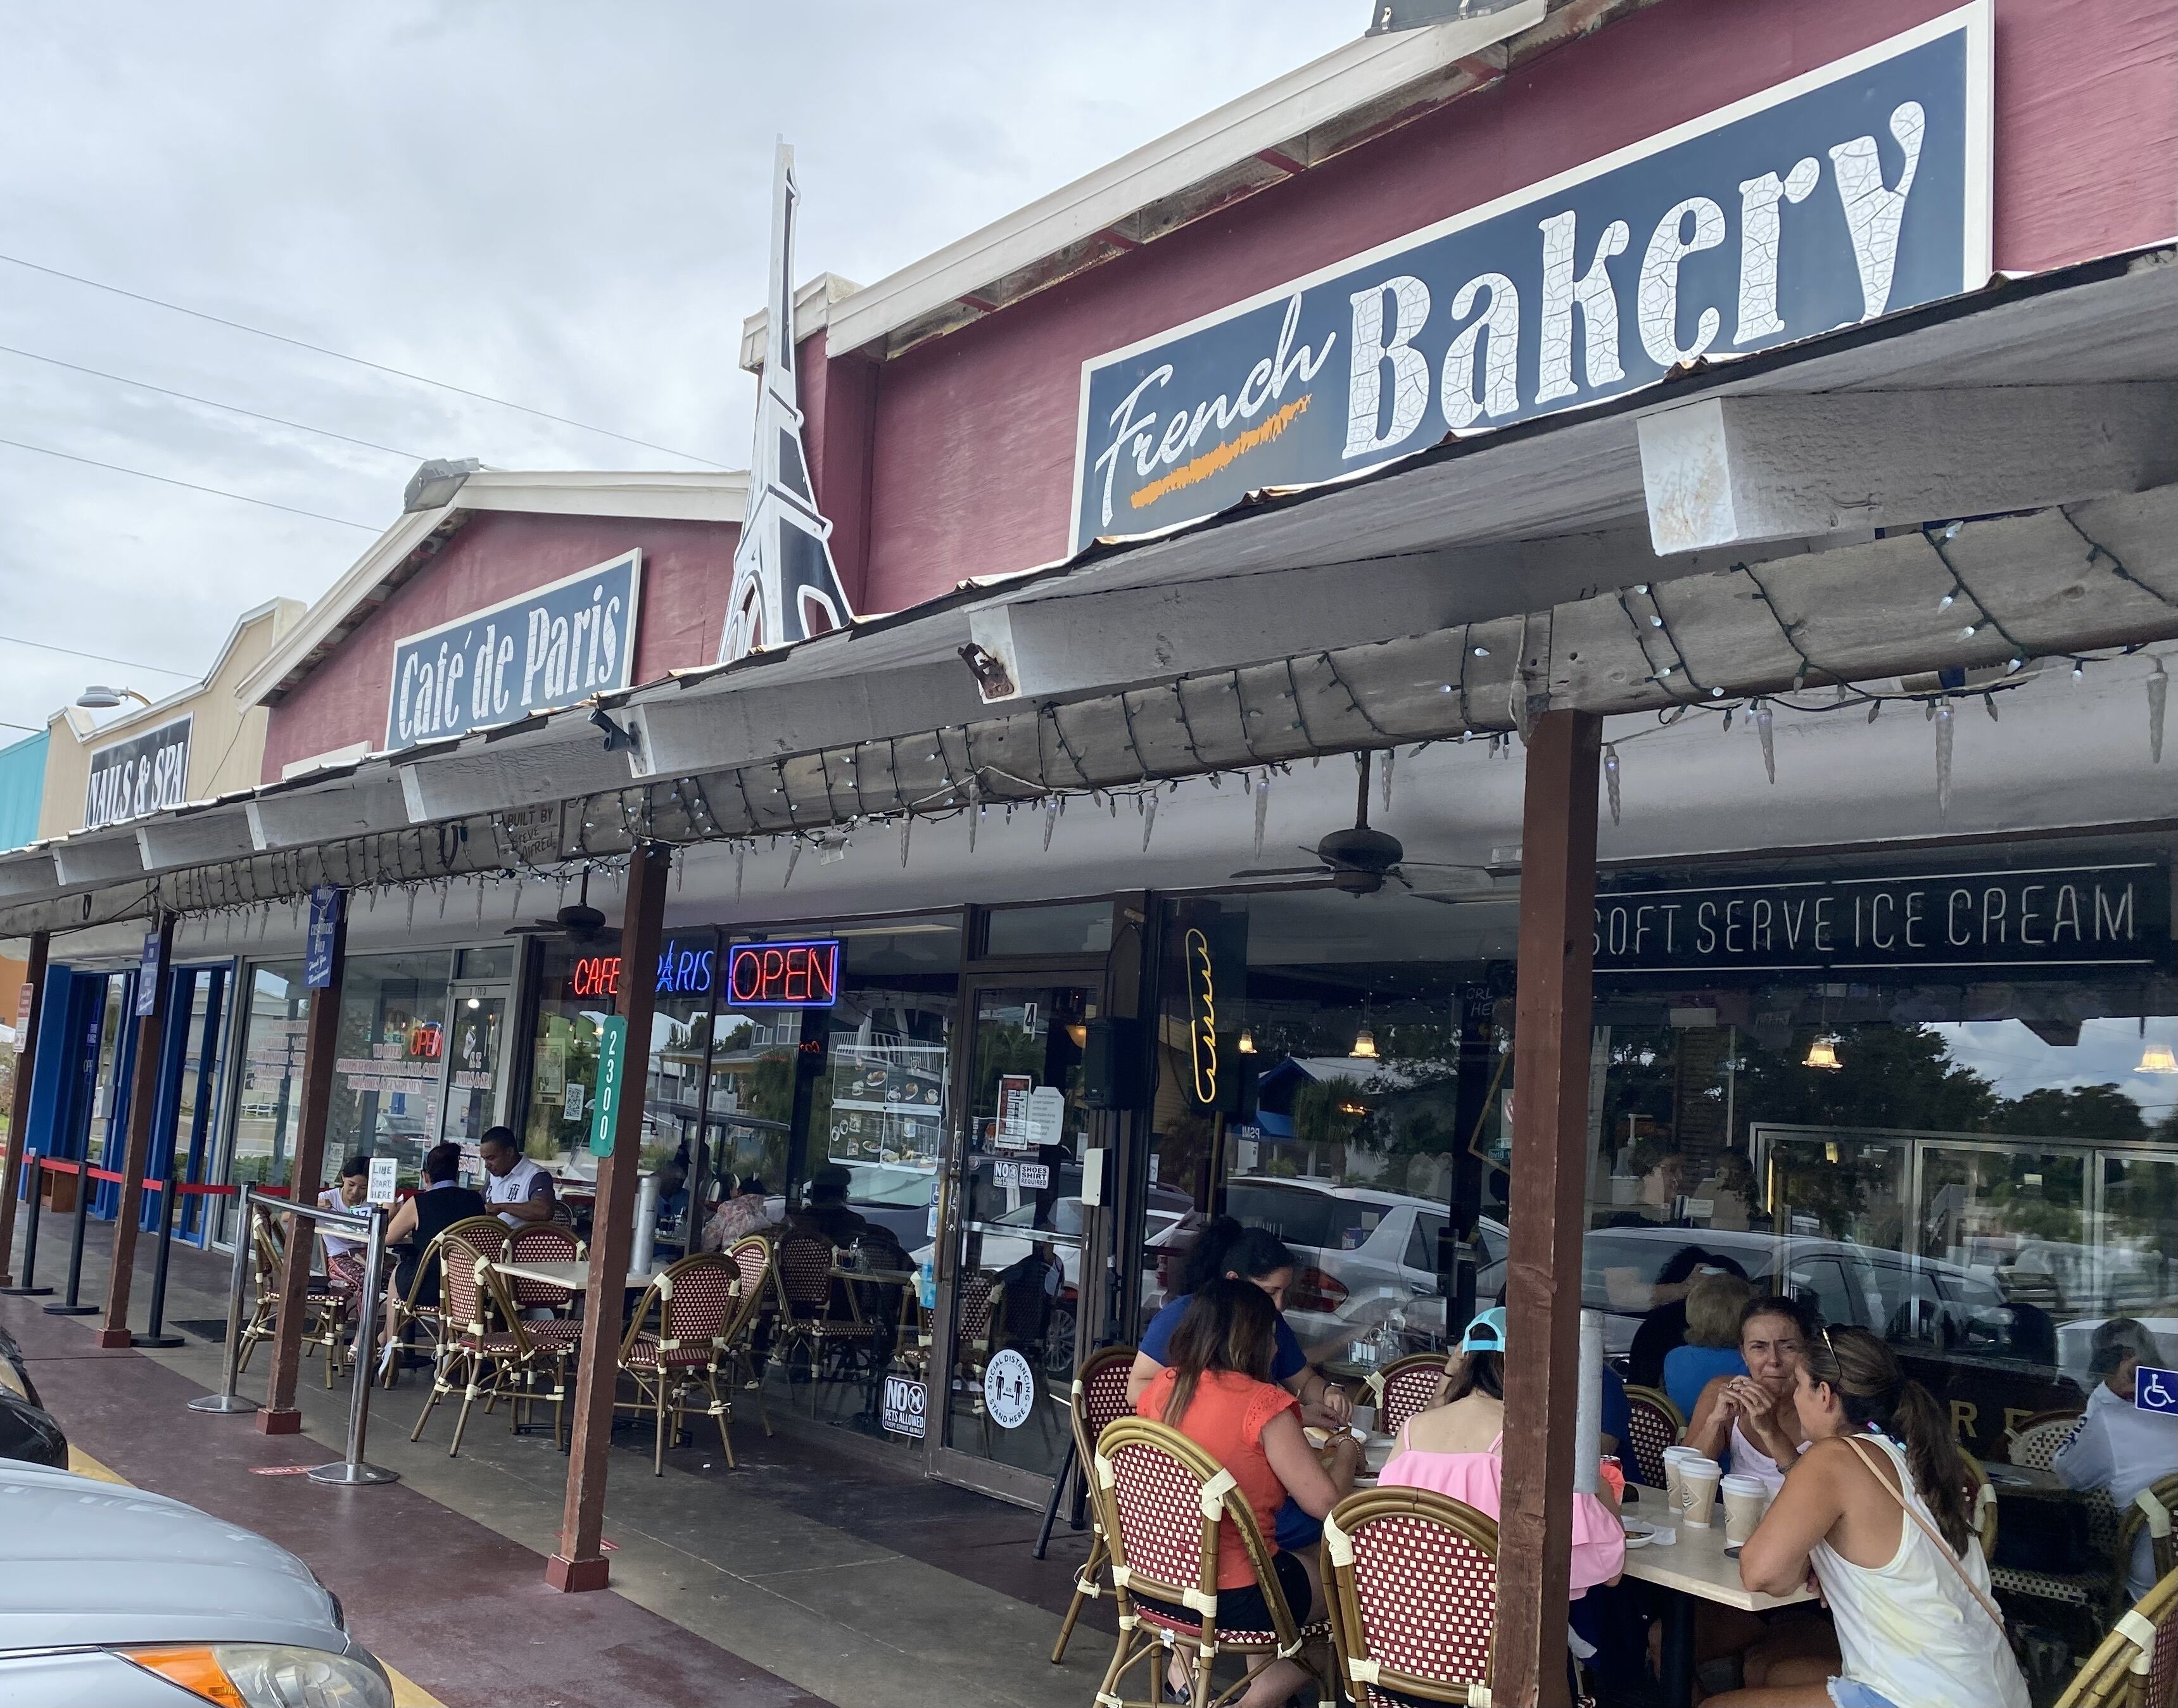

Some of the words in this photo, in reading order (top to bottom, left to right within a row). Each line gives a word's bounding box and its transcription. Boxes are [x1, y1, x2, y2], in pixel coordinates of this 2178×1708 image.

[1095, 292, 1336, 527] French
[1342, 101, 1925, 460] Bakery
[398, 629, 472, 740] Café
[472, 624, 514, 719] de
[521, 585, 620, 706] Paris
[85, 760, 133, 828] NAILS
[134, 754, 150, 815] &
[151, 741, 184, 811] SPA
[507, 810, 536, 827] BUILT
[541, 807, 554, 823] BY
[1697, 896, 1835, 954] SERVE
[1854, 890, 1926, 950] ICE
[1948, 882, 2134, 946] CREAM
[574, 957, 622, 996] CAFE
[732, 945, 835, 1001] OPEN
[1025, 1004, 1035, 1032] 4
[410, 1029, 443, 1058] OPEN
[598, 1030, 618, 1141] 2300
[373, 1166, 392, 1176] LINE
[995, 1163, 1008, 1177] NO
[1021, 1178, 1047, 1186] REQUIRED
[1022, 1166, 1047, 1174] SHOES
[371, 1190, 391, 1199] HERE
[987, 1357, 1003, 1390] SOCIAL
[1004, 1355, 1031, 1401] DISTANCING
[886, 1379, 908, 1412] NO
[885, 1408, 898, 1422] PETS
[898, 1412, 924, 1428] ALLOWED
[989, 1398, 1008, 1423] STAND
[1009, 1408, 1025, 1424] HERE
